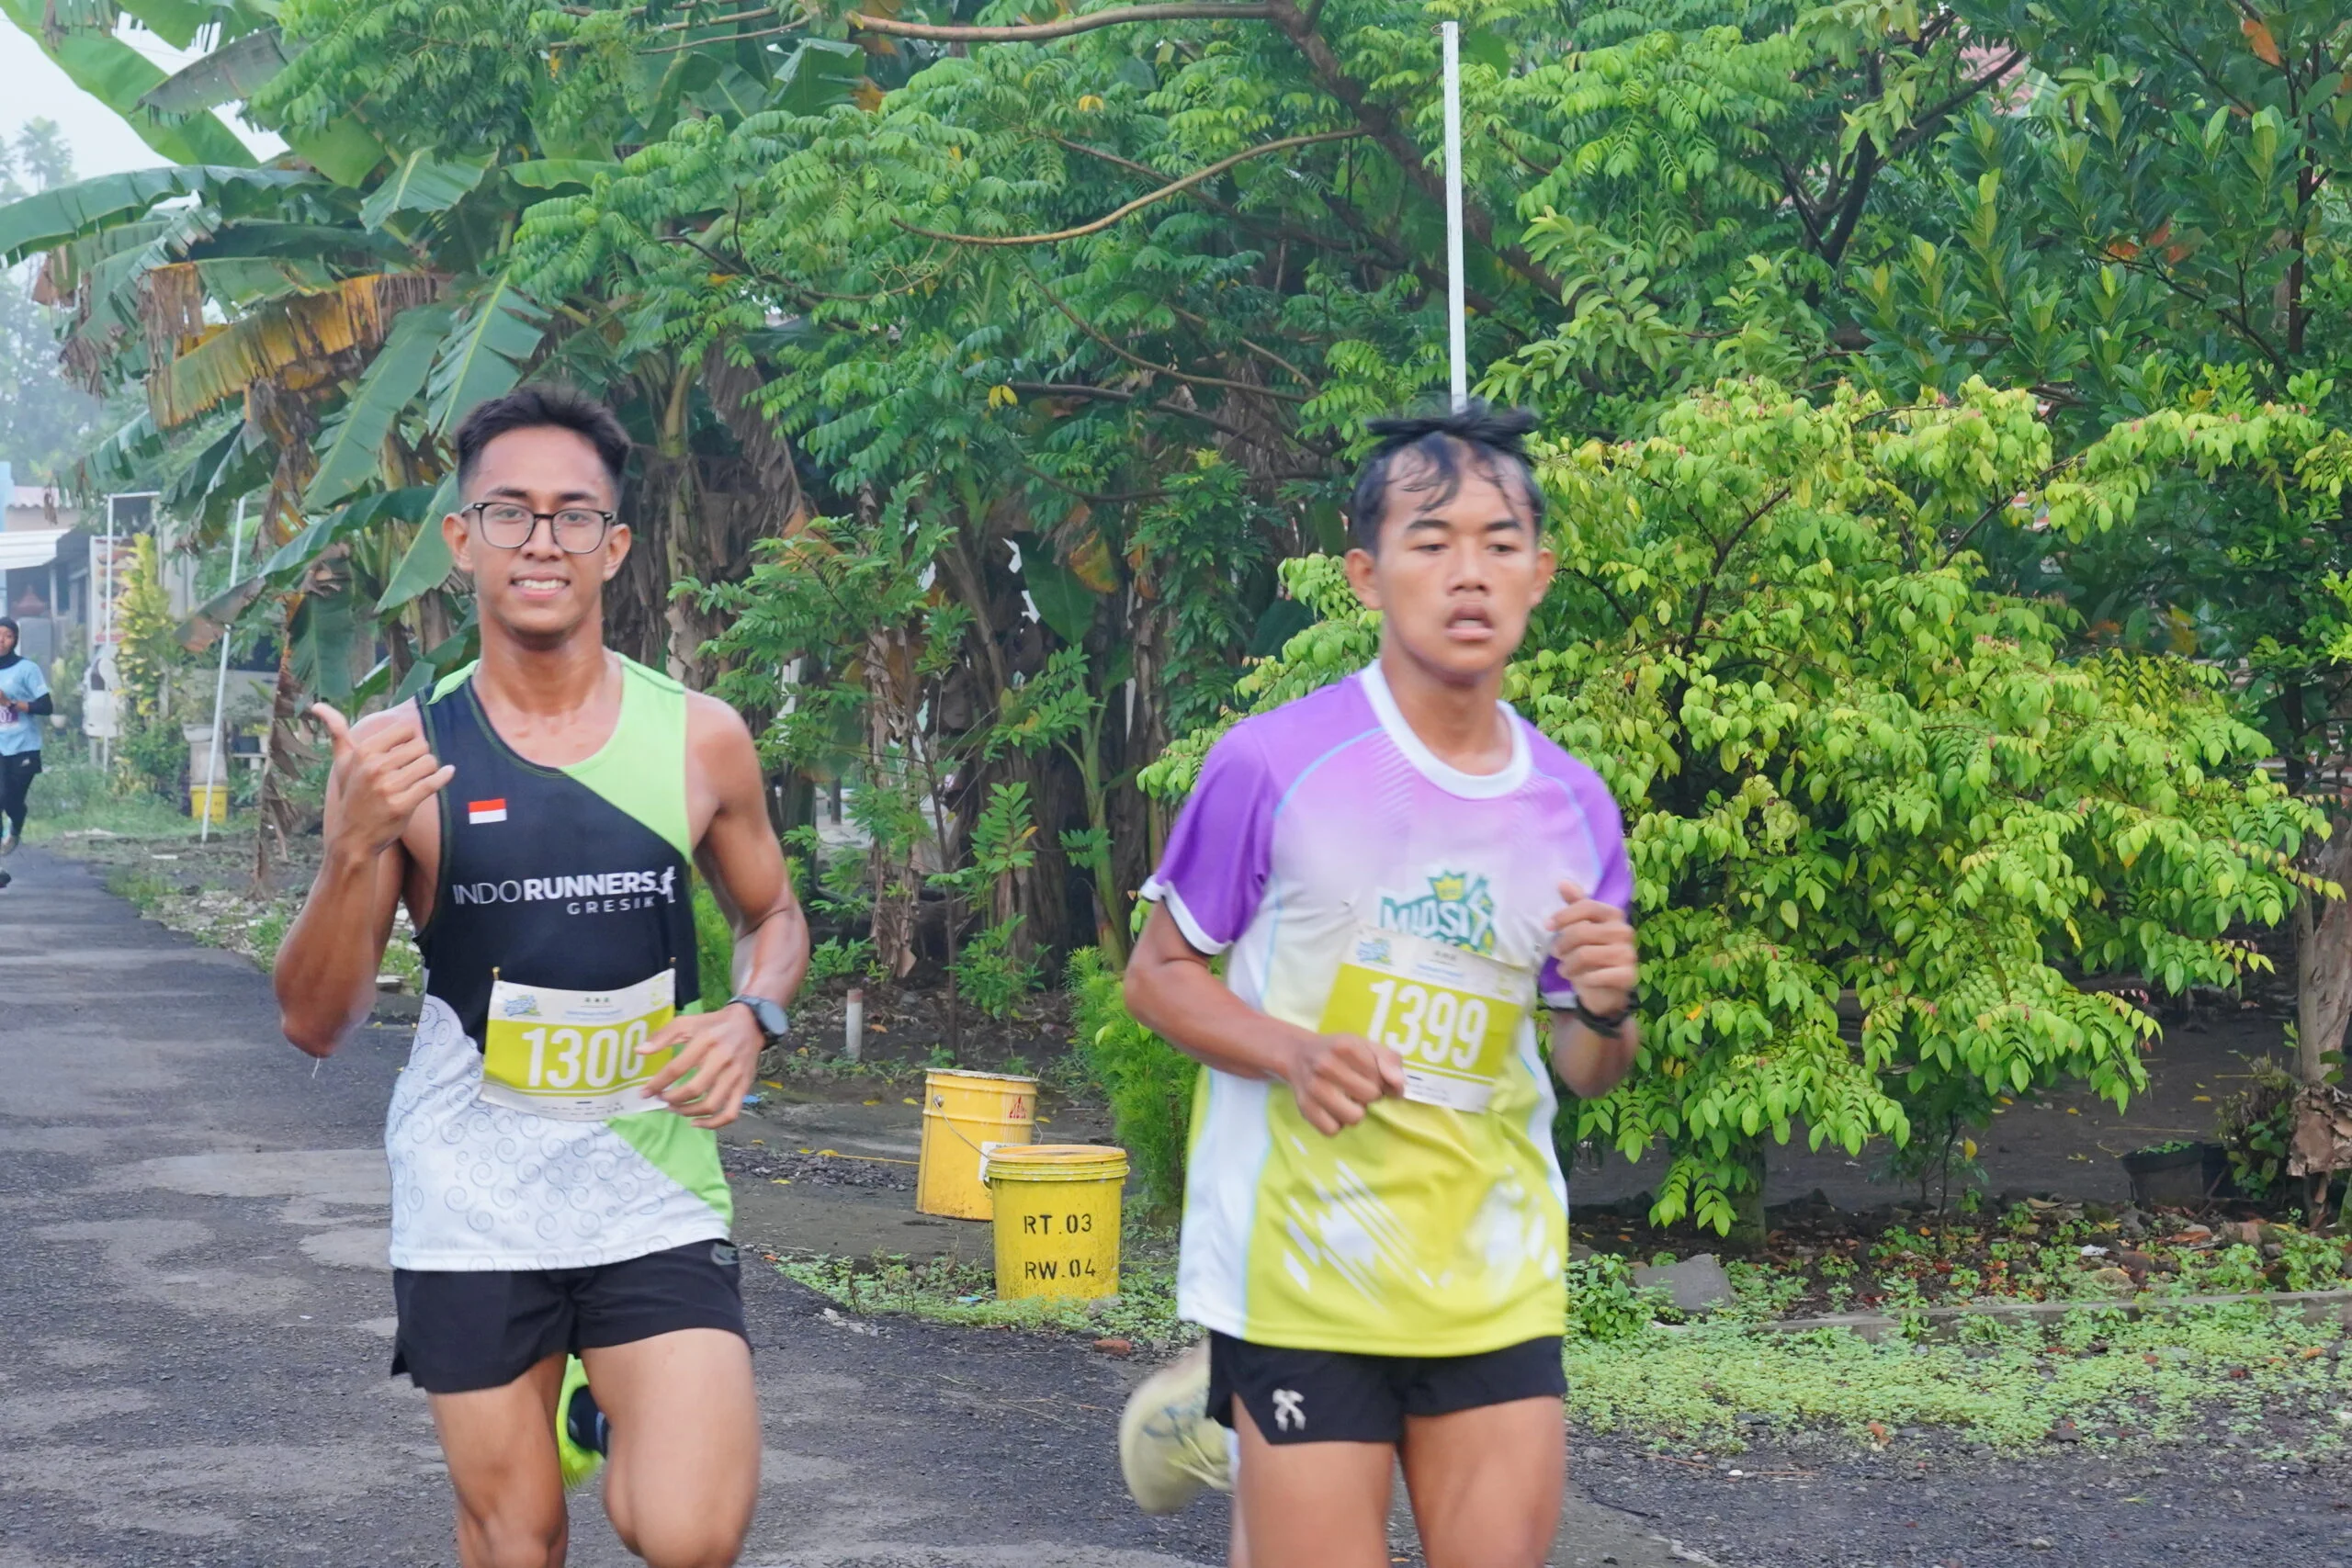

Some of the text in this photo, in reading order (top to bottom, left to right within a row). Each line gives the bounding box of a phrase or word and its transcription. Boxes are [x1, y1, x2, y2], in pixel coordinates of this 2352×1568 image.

[566, 896, 655, 915] GRESIK
[521, 1020, 649, 1089] 1300
[1366, 979, 1488, 1069] 1399
